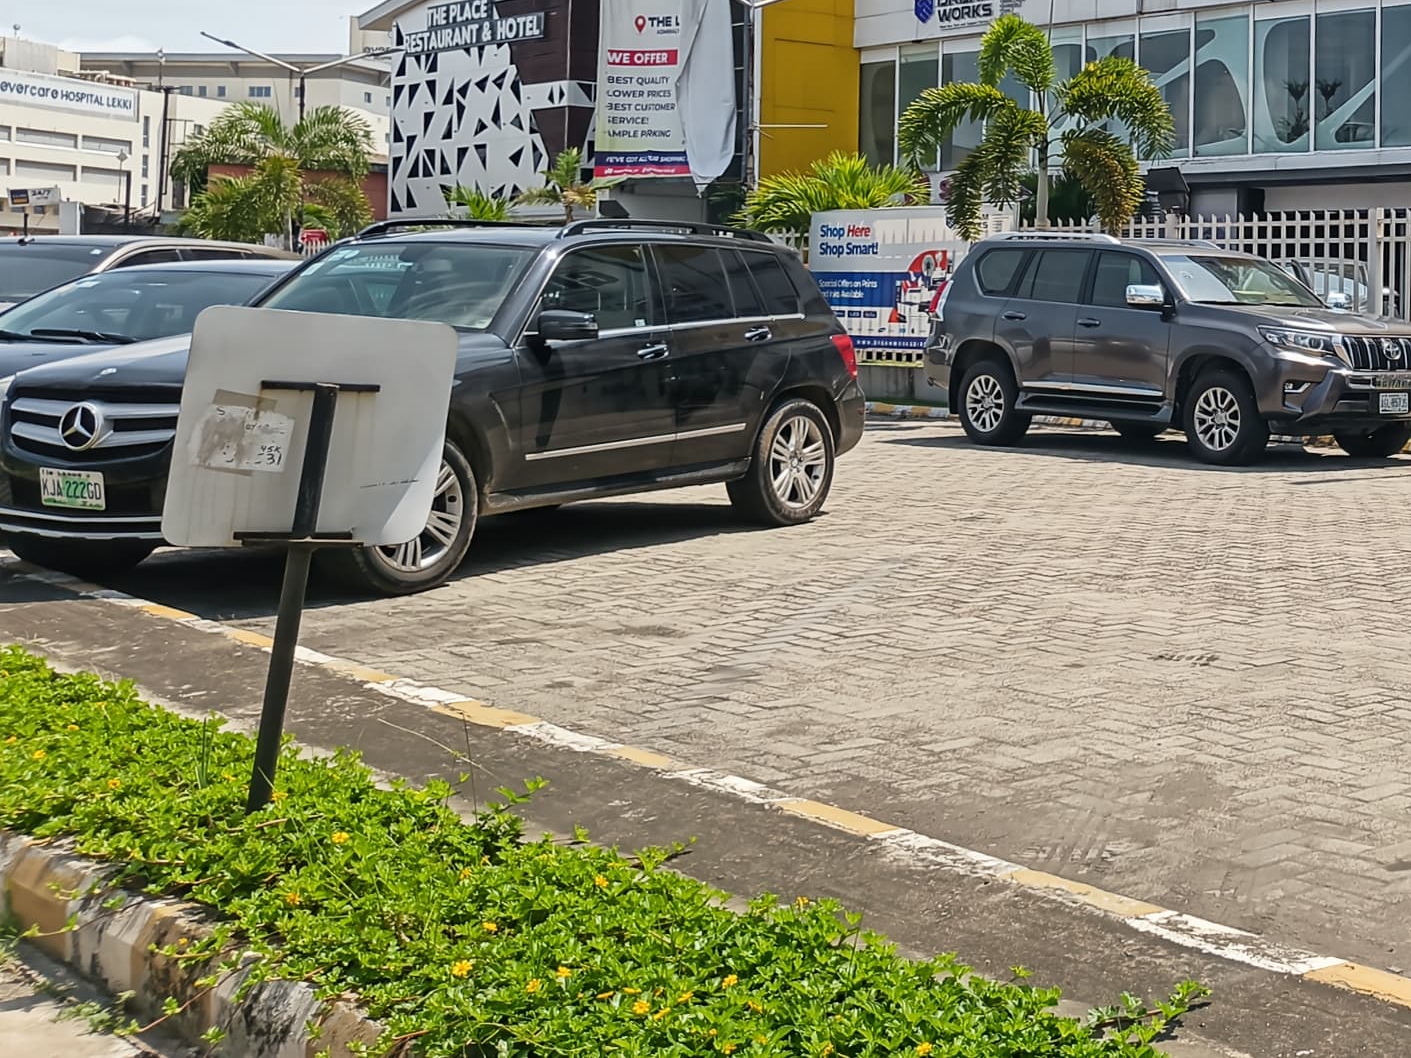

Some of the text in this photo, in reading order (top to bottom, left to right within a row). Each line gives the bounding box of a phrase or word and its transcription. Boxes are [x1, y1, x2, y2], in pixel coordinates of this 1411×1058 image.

[427, 0, 488, 27] THE PLACE
[937, 3, 993, 23] WORKS
[648, 16, 672, 27] THE
[403, 16, 541, 53] RESTAURANT & HOTEL
[608, 51, 668, 64] WE OFFER
[607, 75, 670, 86] BEST QUALITY
[0, 80, 132, 110] evercare HOSPITAL LEKKI
[820, 224, 871, 240] Shop Here
[819, 242, 878, 258] Shop Smart!
